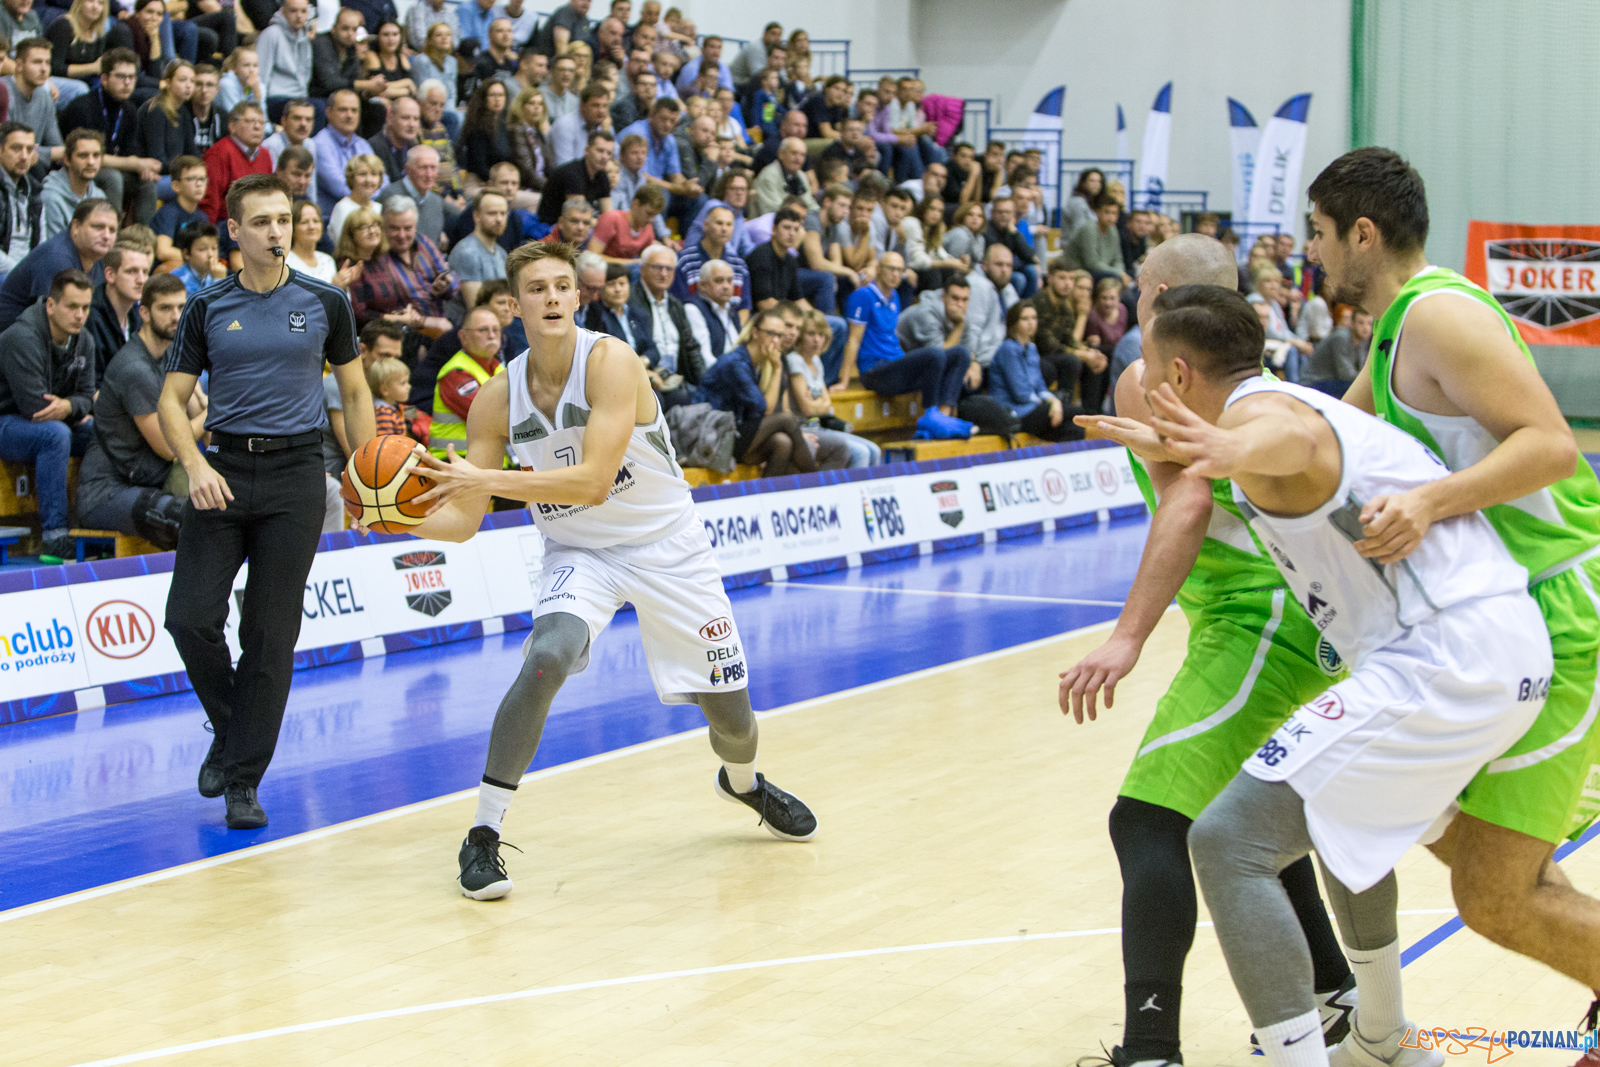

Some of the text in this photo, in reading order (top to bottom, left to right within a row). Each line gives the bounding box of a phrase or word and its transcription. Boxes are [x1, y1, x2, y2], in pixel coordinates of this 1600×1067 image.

[1268, 146, 1289, 215] DELIK
[1505, 266, 1595, 292] JOKER
[995, 479, 1040, 507] NICKEL
[771, 504, 842, 538] BIOFARM
[871, 496, 904, 538] PBG
[702, 514, 763, 548] OFARM
[405, 569, 446, 592] JOKER
[551, 566, 574, 592] 7
[95, 611, 147, 648] KIA
[706, 620, 731, 639] KIA
[15, 651, 76, 672] podróży
[707, 643, 740, 662] DELIK
[722, 661, 746, 685] PBG
